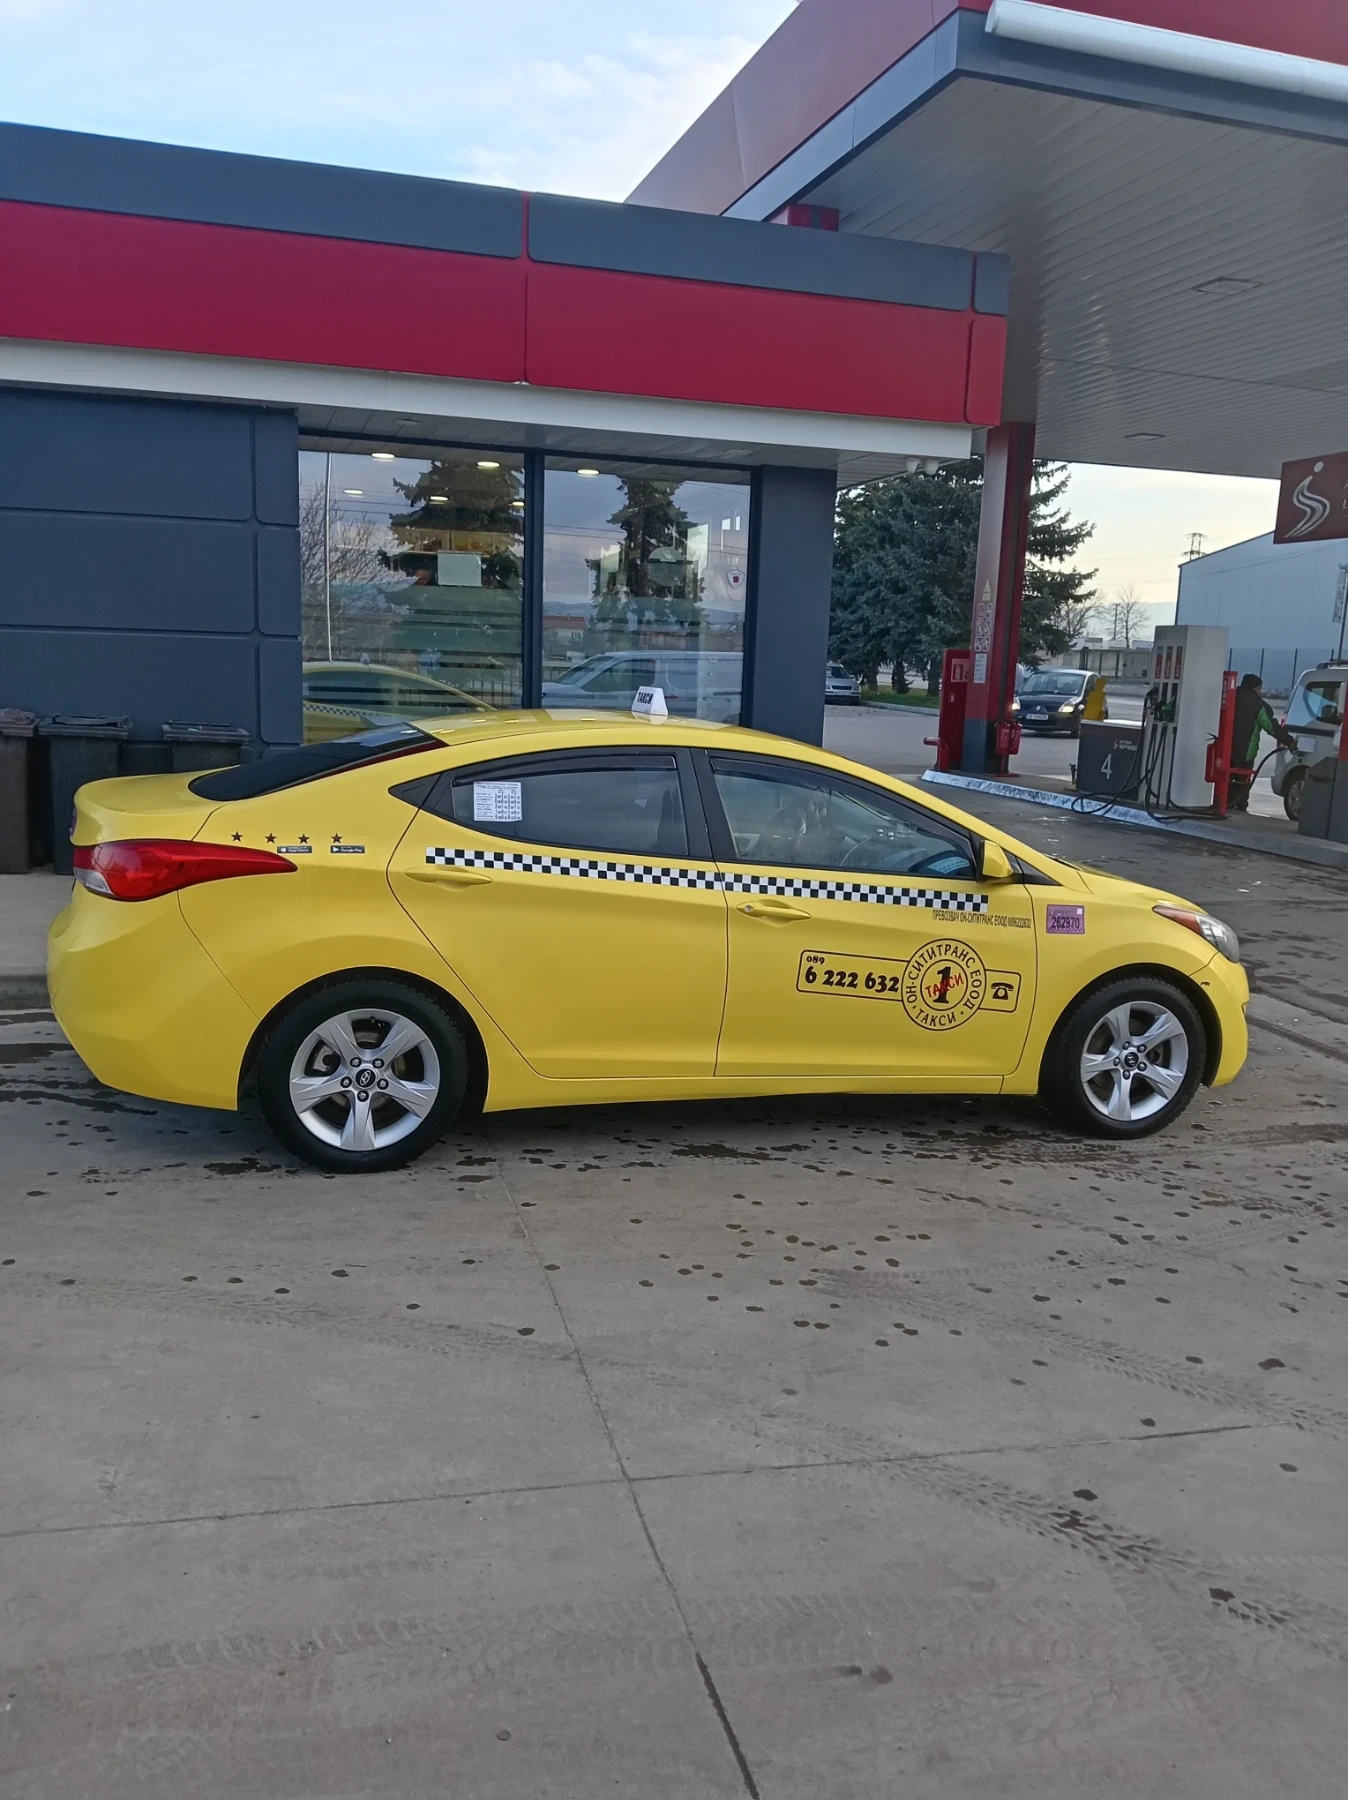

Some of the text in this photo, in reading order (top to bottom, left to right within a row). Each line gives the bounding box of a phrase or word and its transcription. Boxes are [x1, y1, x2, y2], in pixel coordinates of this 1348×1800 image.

[637, 691, 654, 704] ТАКСИ
[1101, 753, 1112, 779] 4
[1051, 916, 1080, 929] 262970
[806, 956, 825, 965] 089
[805, 965, 900, 993] 6 222 632
[905, 943, 982, 1010] ОН-СИТИТРАНС ЕООД
[924, 972, 964, 998] ТАКСИ
[932, 966, 952, 1004] 1
[915, 1008, 957, 1027] ТАКСИ
